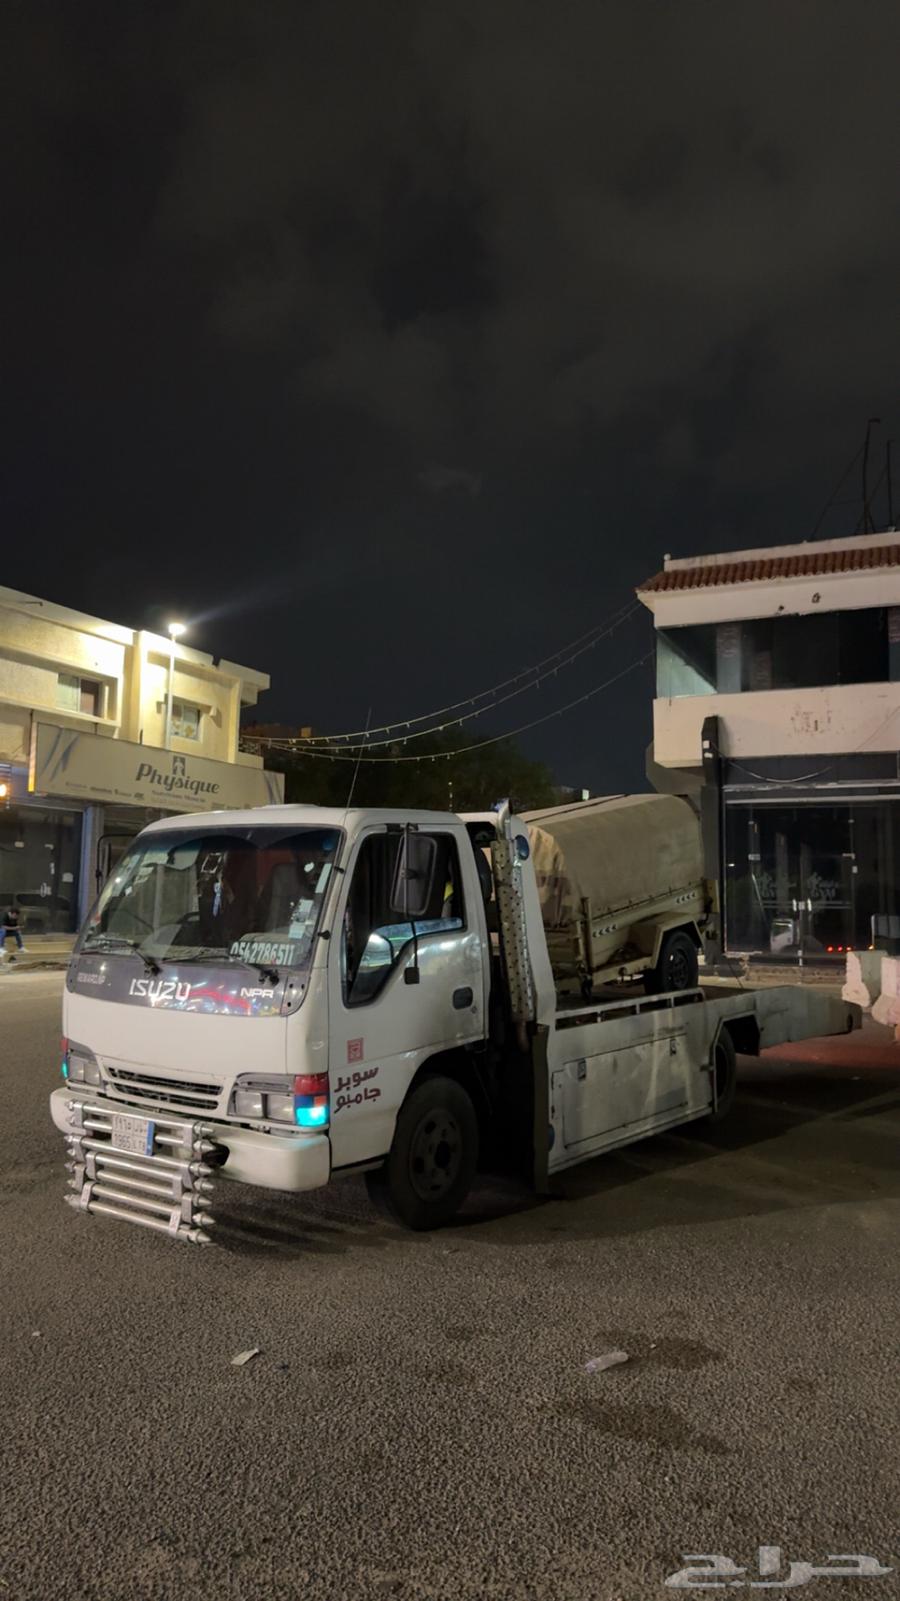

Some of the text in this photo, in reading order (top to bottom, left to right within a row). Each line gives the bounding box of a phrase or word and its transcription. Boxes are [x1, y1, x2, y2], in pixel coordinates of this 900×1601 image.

[135, 763, 220, 796] Physique
[129, 978, 274, 1001] ISUZU NPR
[334, 1067, 380, 1093] سوبر
[334, 1087, 381, 1114] جامبو
